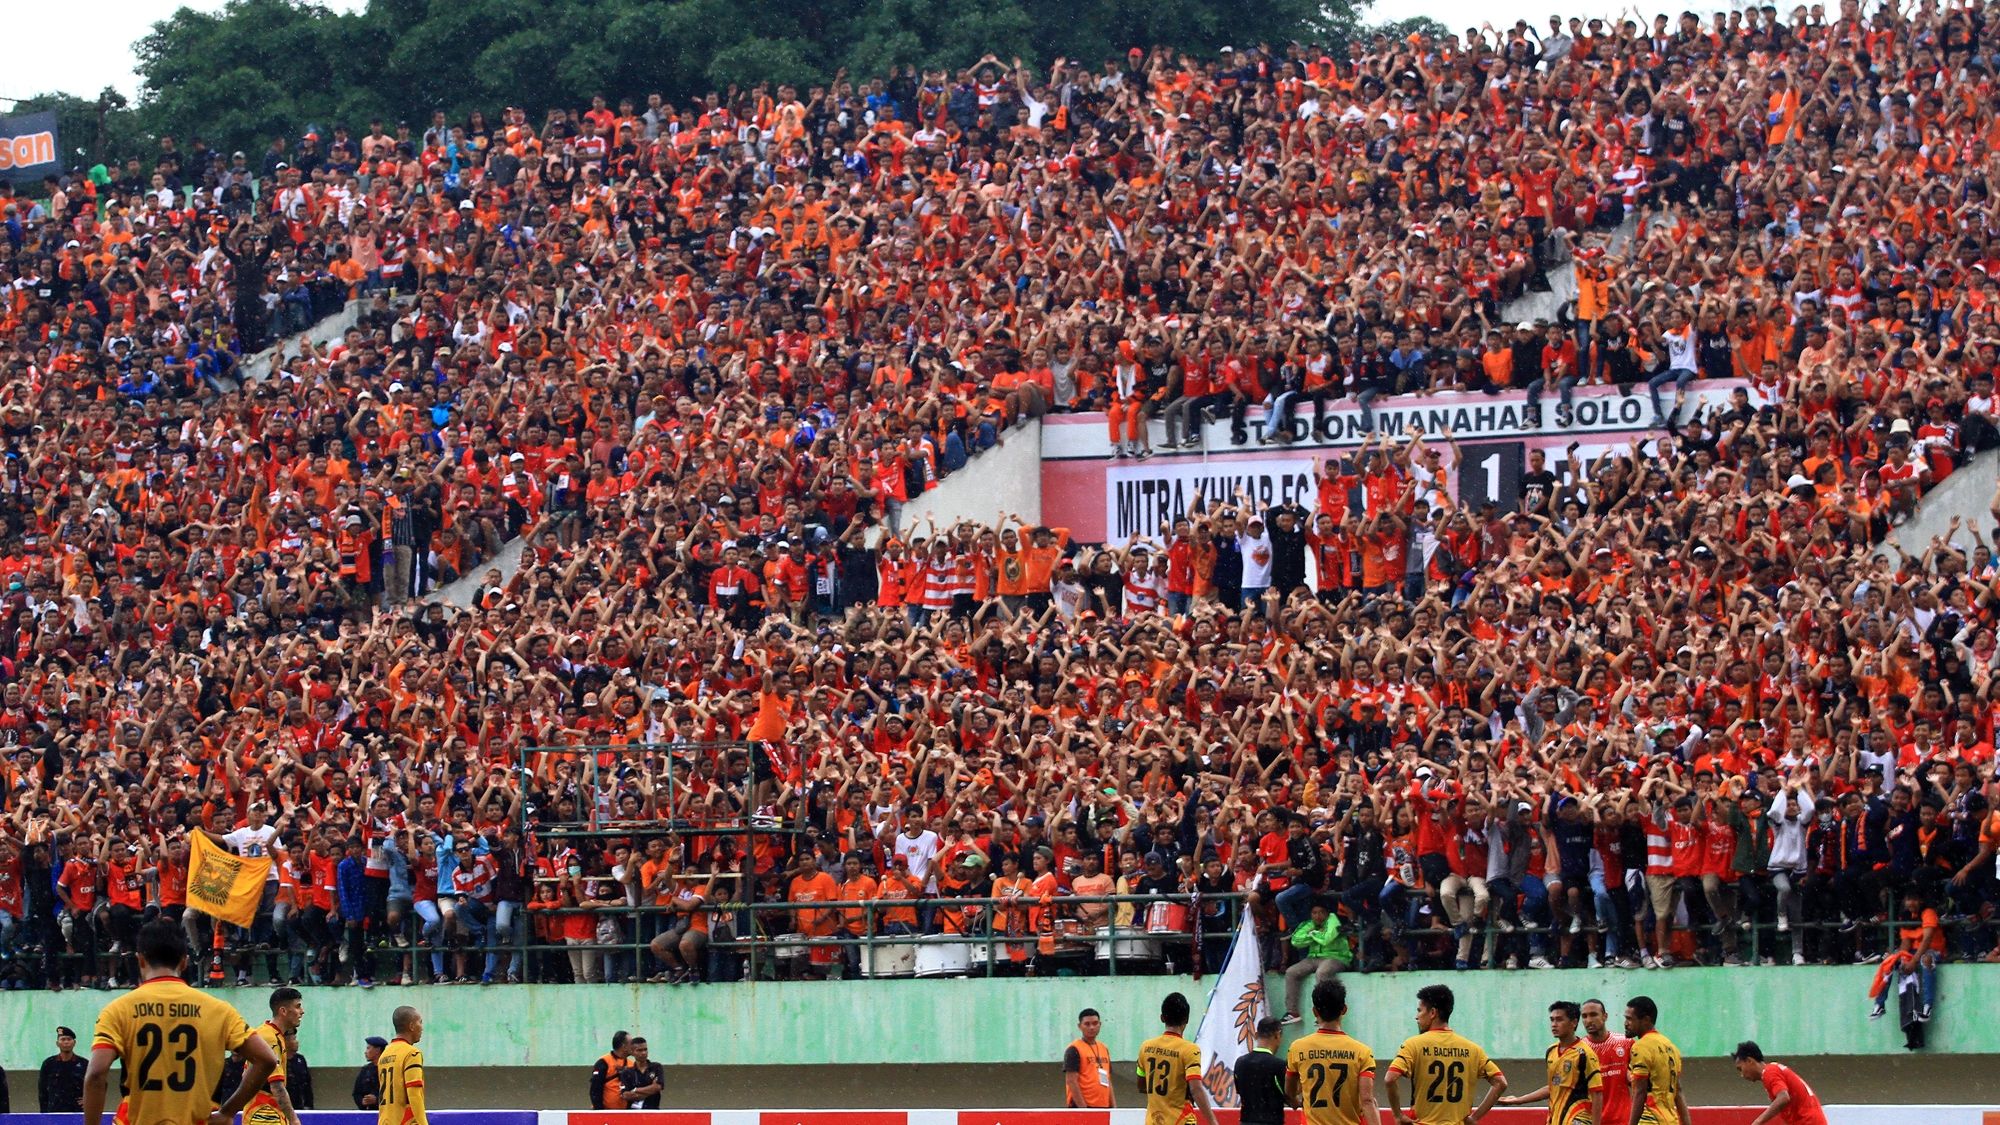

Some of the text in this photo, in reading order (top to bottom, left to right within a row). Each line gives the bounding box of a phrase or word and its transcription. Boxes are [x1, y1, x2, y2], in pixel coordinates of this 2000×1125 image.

[1230, 398, 1642, 446] STDON MANAHAN SOLO
[1480, 453, 1500, 502] 1
[1116, 477, 1186, 539] MITRA
[132, 1002, 202, 1019] JOKO SIDIK
[136, 1022, 198, 1092] 23
[1308, 1049, 1355, 1061] GUSMAWAN
[1422, 1046, 1470, 1058] M. BACHTIAR
[379, 1066, 394, 1106] 21
[1146, 1056, 1171, 1096] 13
[1306, 1062, 1349, 1108] 27
[1426, 1060, 1465, 1103] 26
